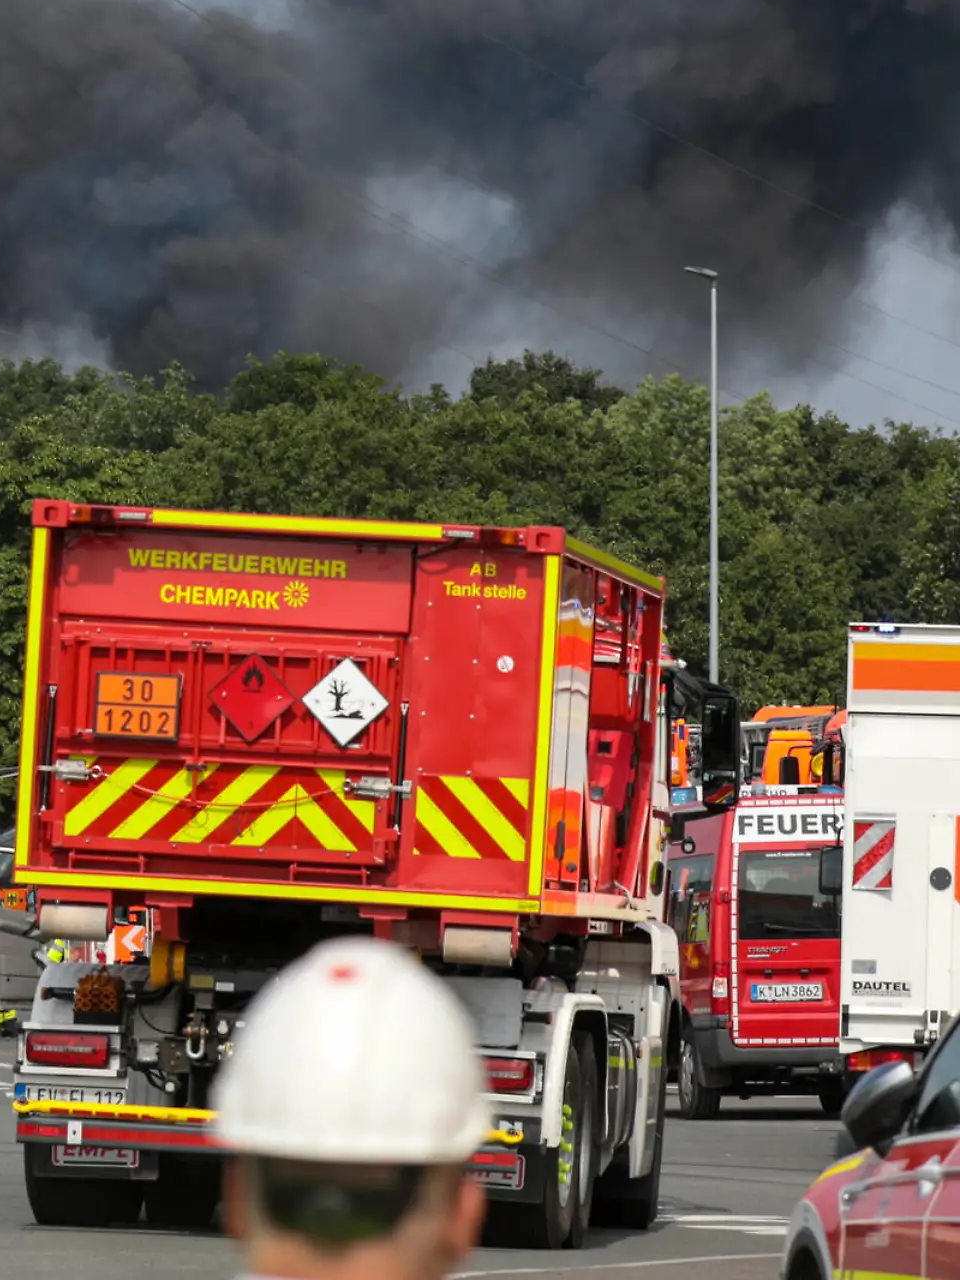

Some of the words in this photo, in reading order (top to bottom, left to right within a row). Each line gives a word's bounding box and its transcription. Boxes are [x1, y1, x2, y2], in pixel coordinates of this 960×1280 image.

[128, 548, 347, 578] WERKFEUERWEHR
[160, 584, 280, 610] CHEMPARK
[122, 678, 154, 702] 30
[104, 708, 170, 734] 1202
[738, 813, 845, 836] FEUER
[852, 980, 911, 992] DAUTEL
